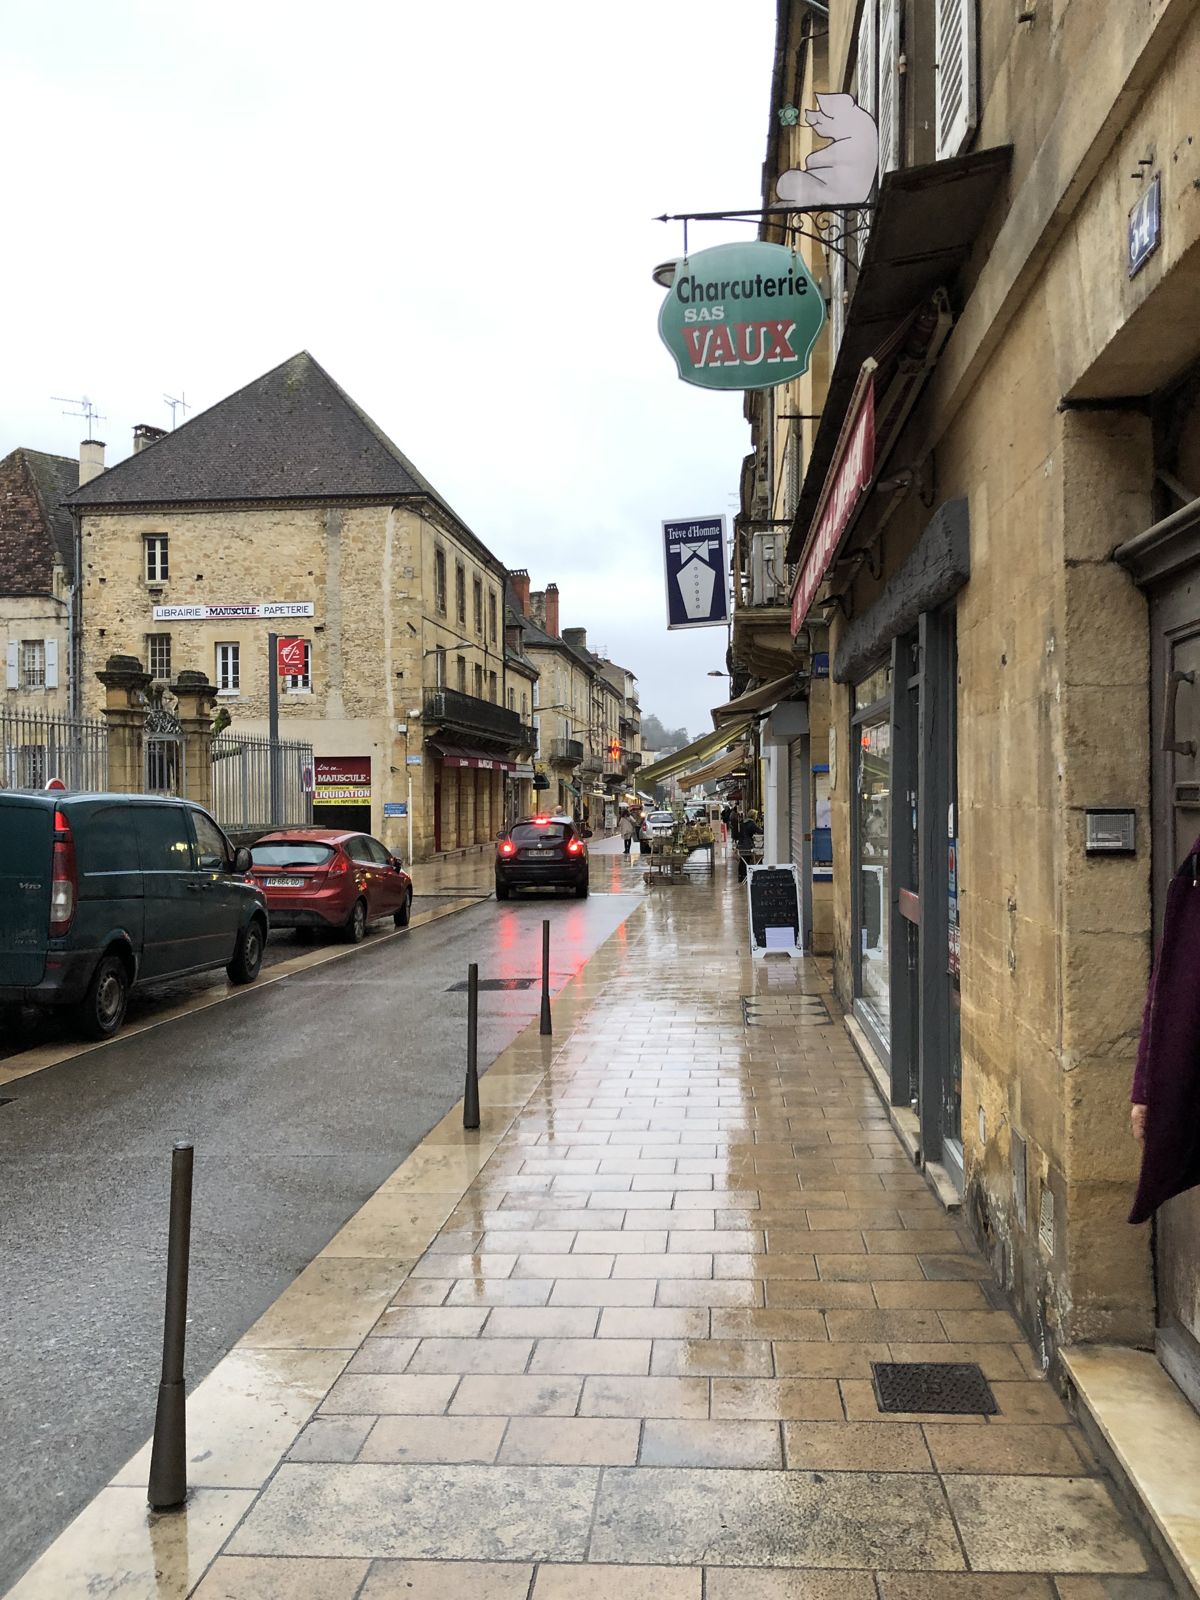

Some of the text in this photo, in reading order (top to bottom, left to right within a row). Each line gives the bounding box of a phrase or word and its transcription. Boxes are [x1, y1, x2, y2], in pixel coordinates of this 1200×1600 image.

[676, 268, 808, 303] Charcuterie
[684, 306, 725, 323] SAS
[681, 319, 798, 368] VAUX
[687, 525, 720, 538] d'Homme
[156, 605, 309, 617] LIBRAIRIE MAJUSCULE PAPETERIE
[317, 774, 366, 782] MAJUSCULE
[314, 790, 370, 799] LIQUIDATION
